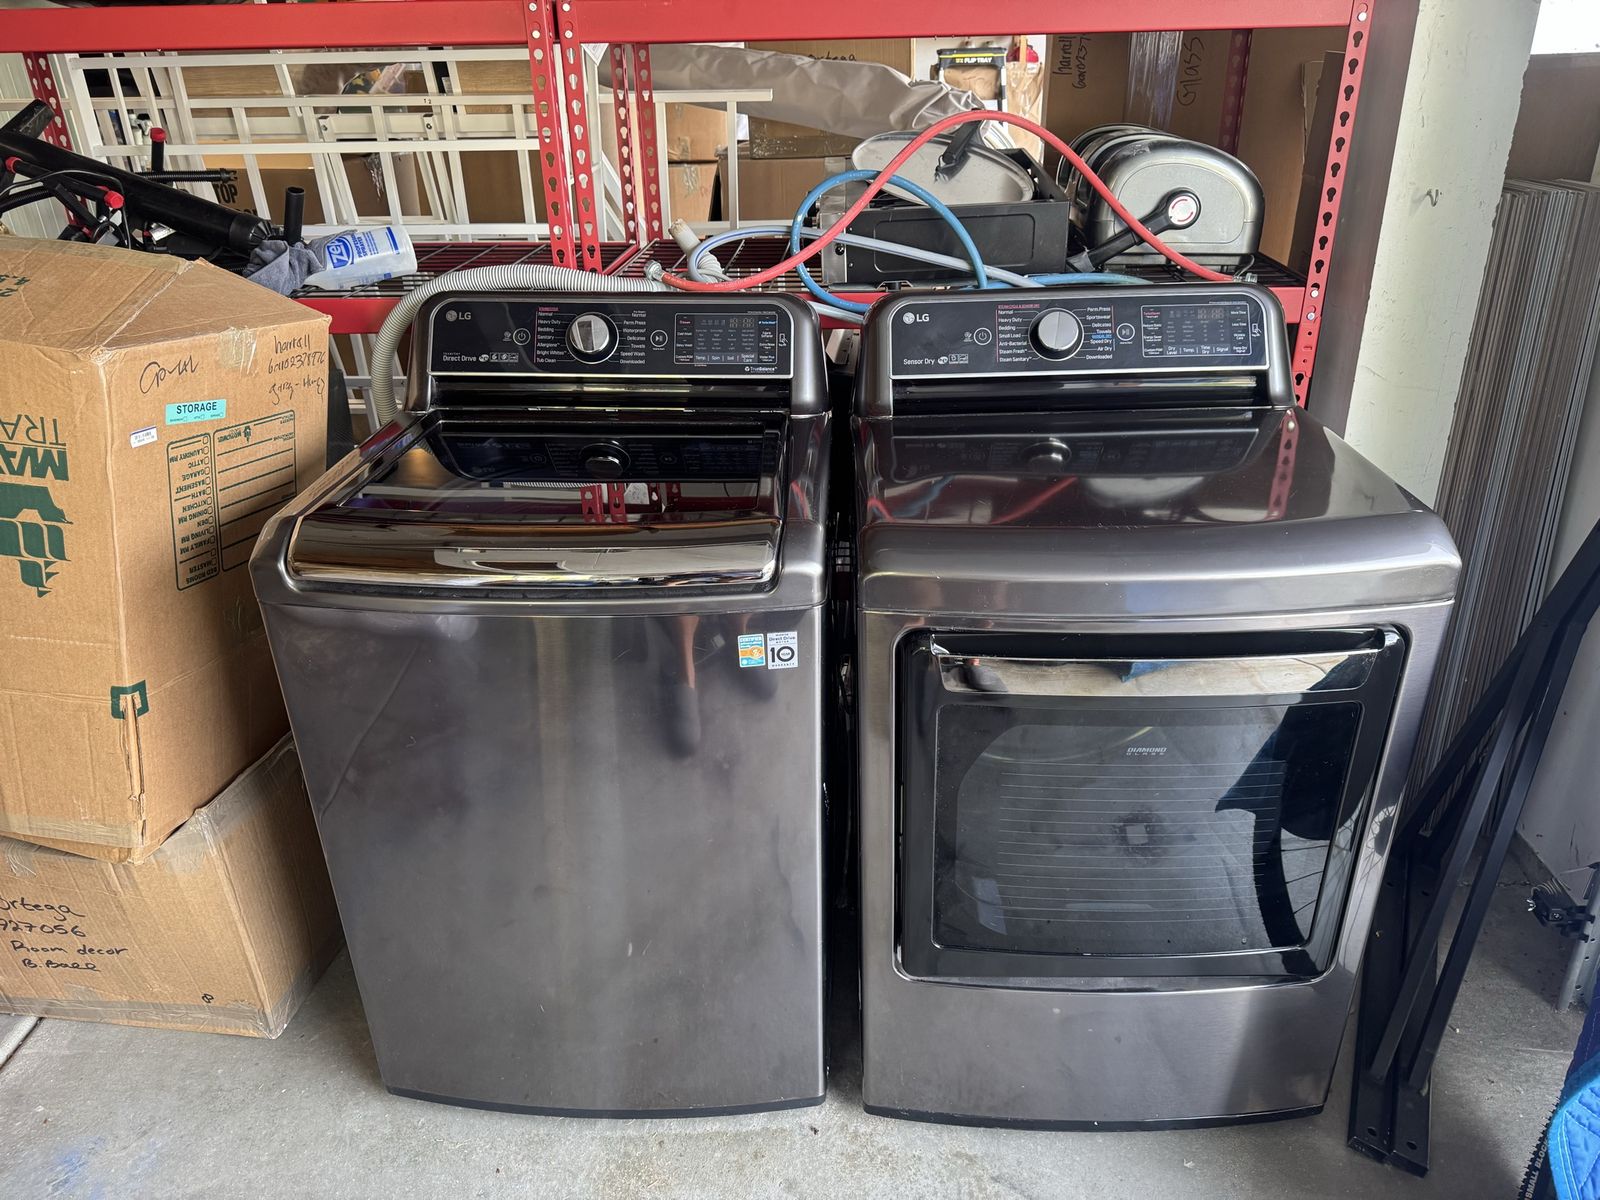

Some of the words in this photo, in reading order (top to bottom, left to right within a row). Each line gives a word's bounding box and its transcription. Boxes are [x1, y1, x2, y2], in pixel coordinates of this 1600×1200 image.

[1177, 37, 1205, 107] Glass
[459, 312, 472, 320] LG
[916, 314, 930, 322] LG
[903, 358, 924, 366] Sensor
[924, 357, 936, 366] Dry
[176, 402, 218, 415] STORAGE
[0, 443, 70, 481] MA
[187, 459, 205, 469] ATTIC
[182, 469, 205, 481] GARAGE
[770, 645, 795, 663] 10
[10, 939, 69, 954] Room
[76, 944, 129, 956] decor
[1525, 1170, 1539, 1198] SMALL
